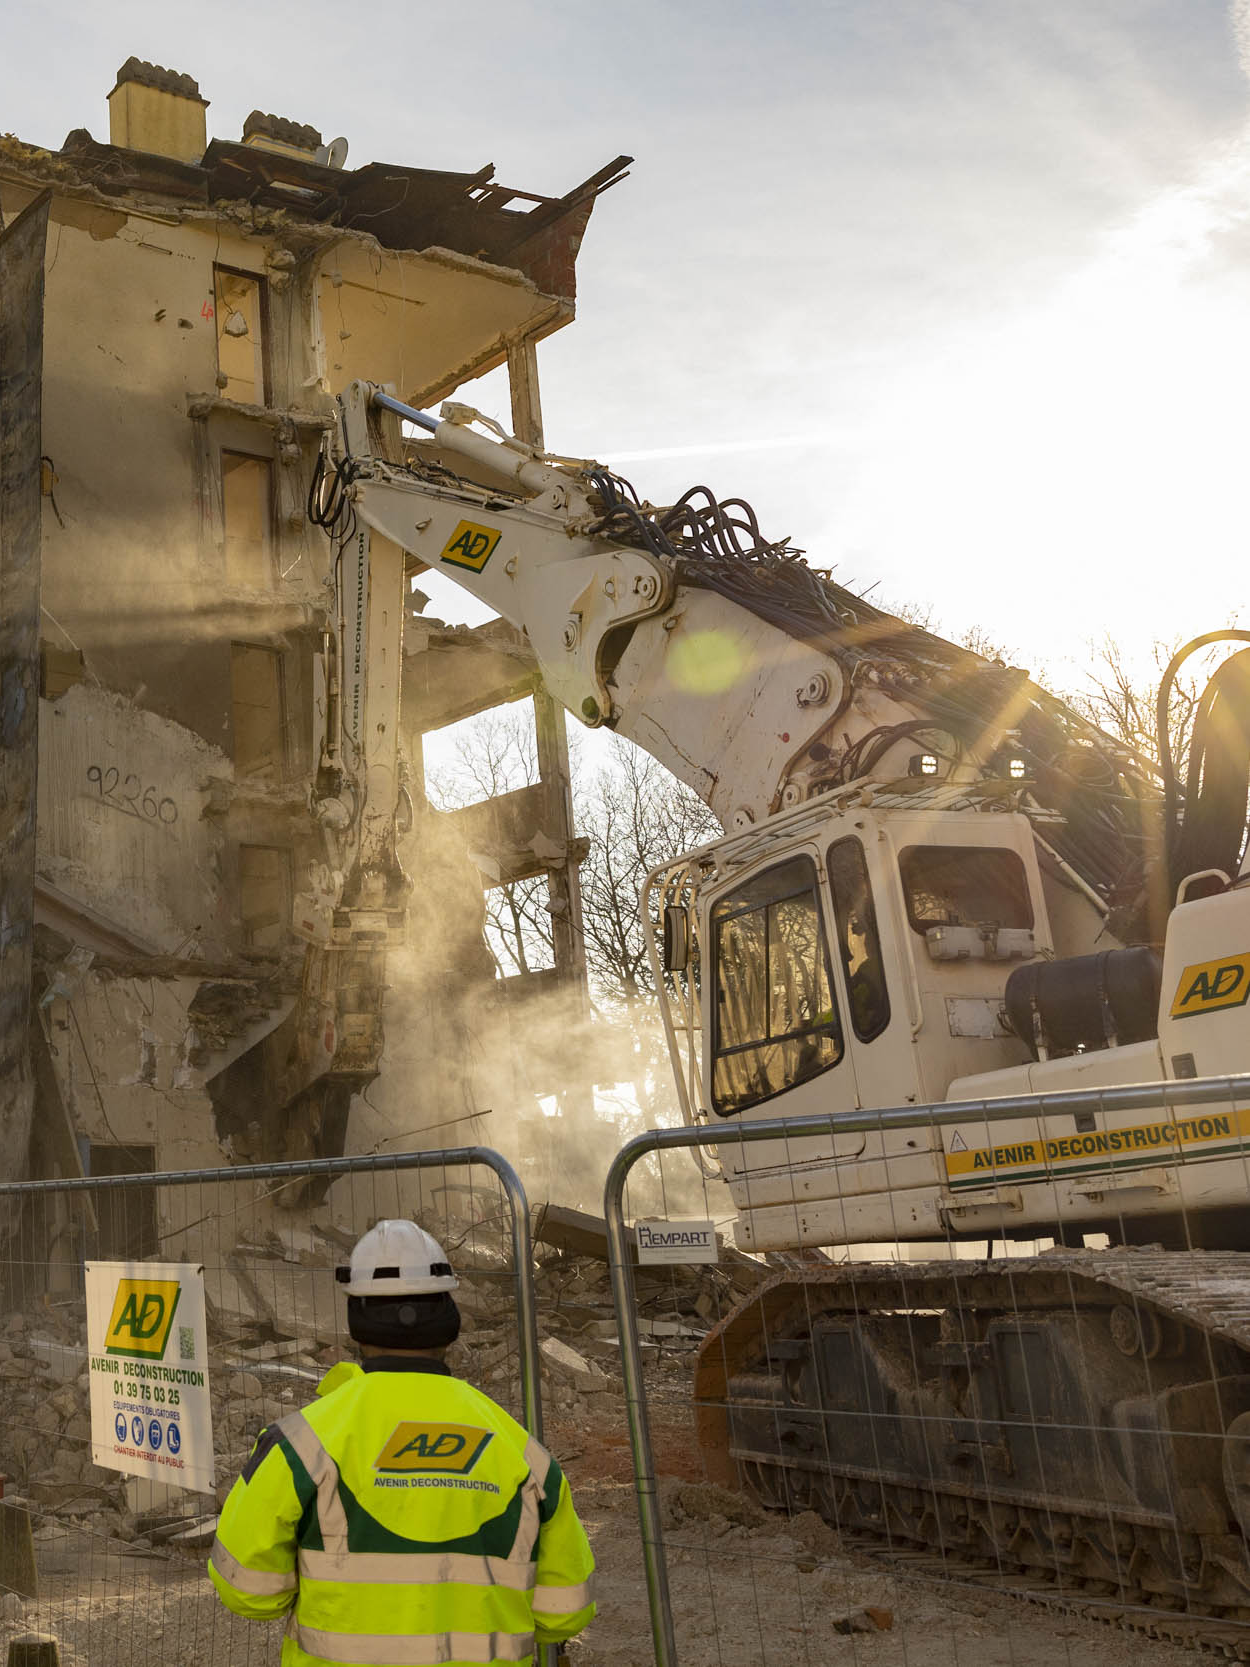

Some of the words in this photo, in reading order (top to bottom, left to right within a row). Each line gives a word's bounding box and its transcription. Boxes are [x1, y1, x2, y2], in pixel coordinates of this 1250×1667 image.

[448, 530, 490, 559] AD
[354, 533, 364, 674] DECONSTRUCTION
[1180, 964, 1244, 1006] AD
[973, 1144, 1036, 1169] AVENIR
[1047, 1116, 1230, 1159] DECONSTRUCTION
[638, 1227, 710, 1246] REMPART
[113, 1293, 165, 1339] AD
[91, 1357, 119, 1374] AVENIR
[123, 1362, 204, 1387] DECONSTRUCTION
[114, 1380, 123, 1395] 01
[126, 1382, 137, 1398] 39
[140, 1384, 150, 1400] 75
[154, 1386, 165, 1403] 03
[168, 1388, 180, 1405] 25
[158, 1455, 165, 1465] AU
[392, 1433, 466, 1458] AD
[374, 1477, 409, 1488] AVENIR
[411, 1477, 500, 1495] DECONSTRUCTION
